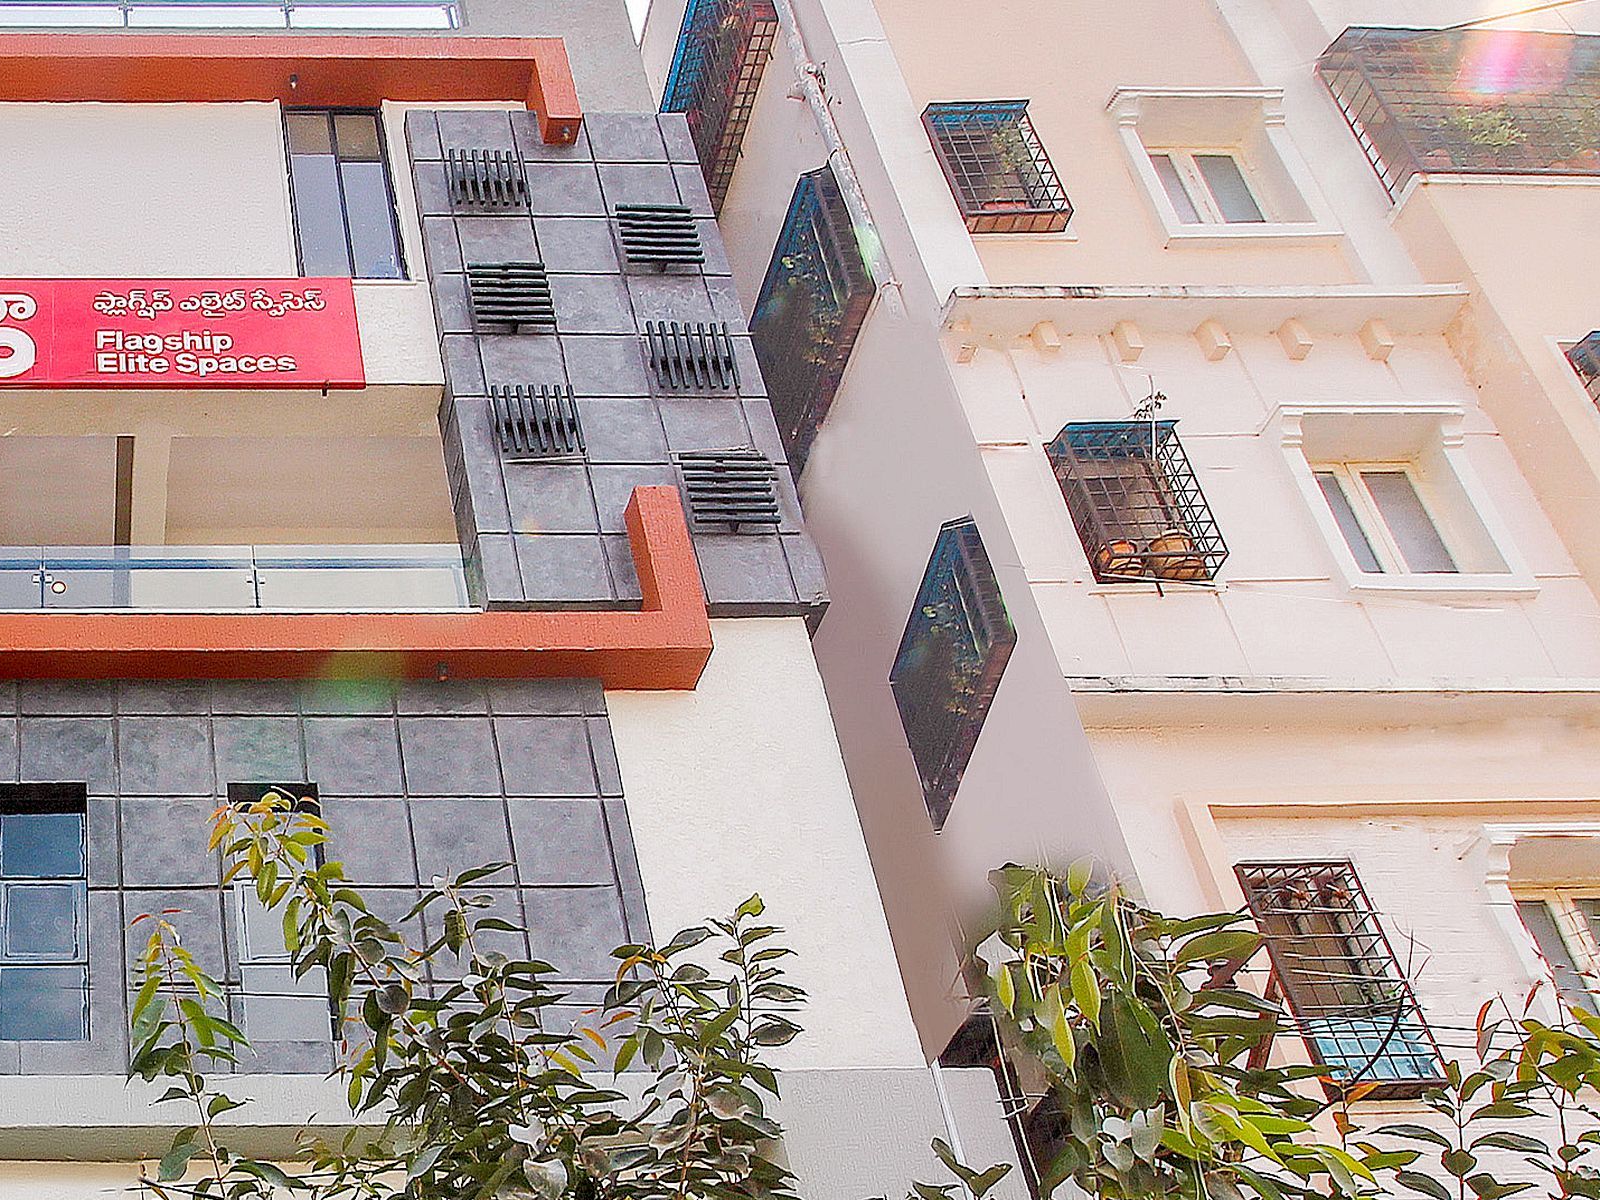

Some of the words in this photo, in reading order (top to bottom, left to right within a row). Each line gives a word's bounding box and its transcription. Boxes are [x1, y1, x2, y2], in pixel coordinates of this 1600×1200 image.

[96, 330, 233, 354] Flagship
[96, 352, 170, 373] Elite
[175, 353, 296, 377] Spaces
